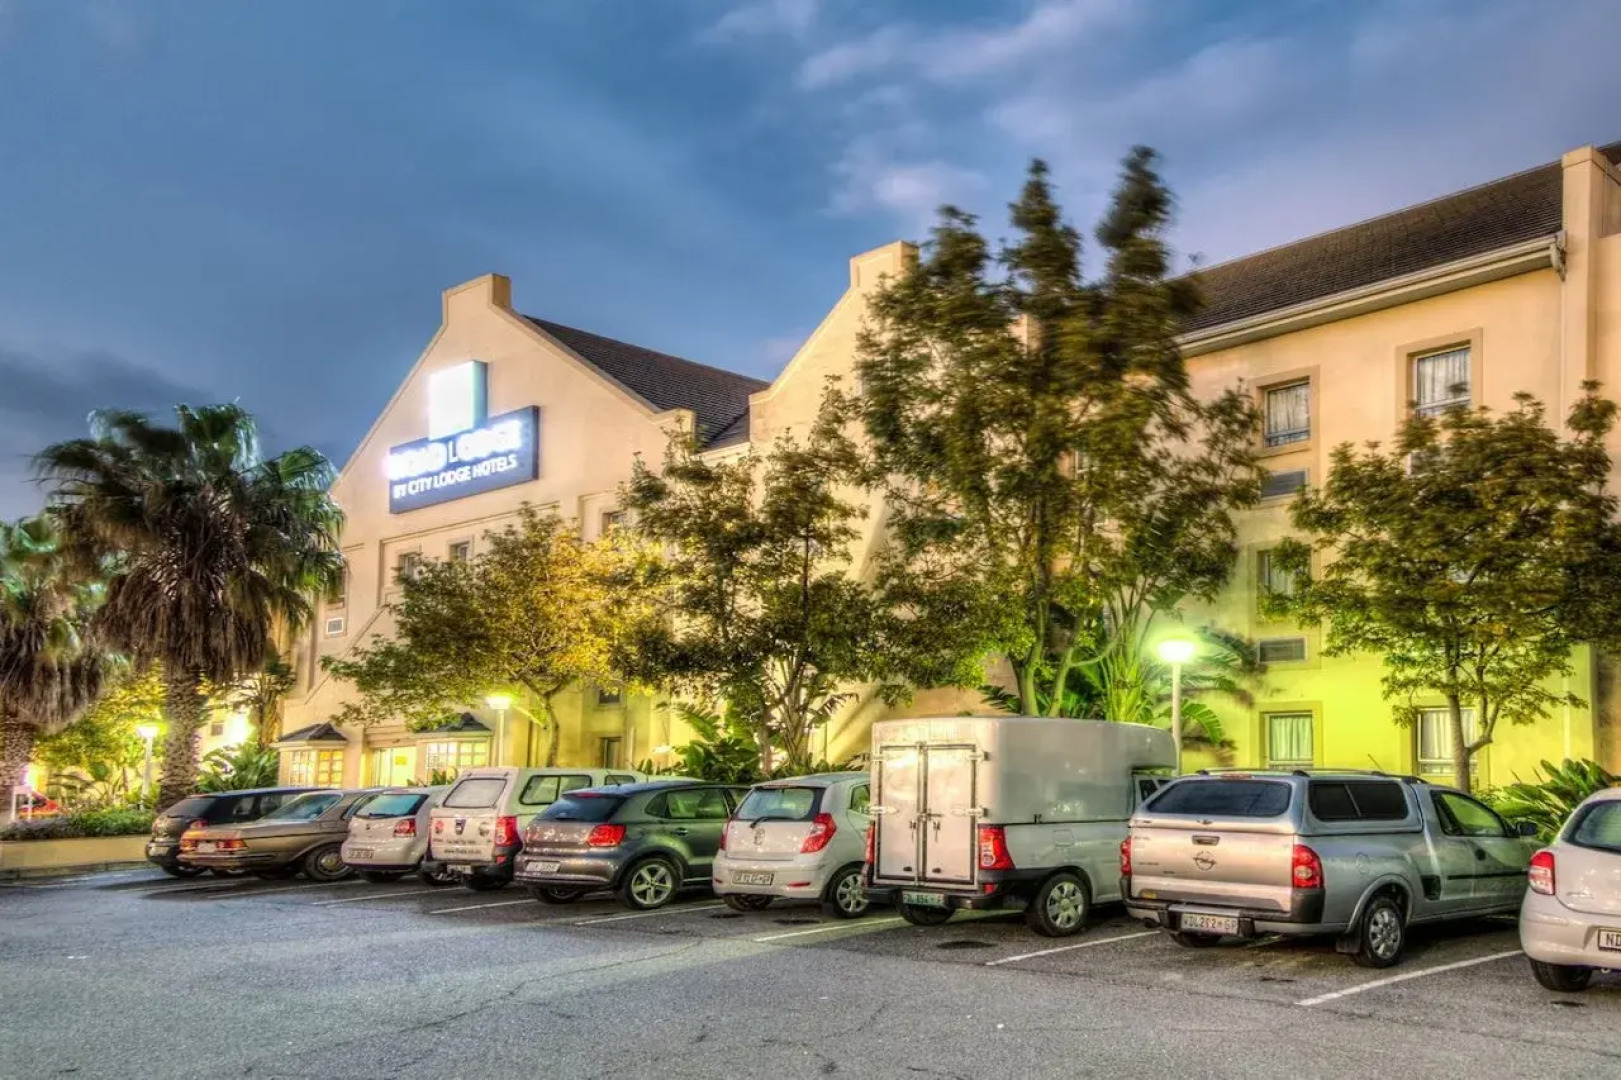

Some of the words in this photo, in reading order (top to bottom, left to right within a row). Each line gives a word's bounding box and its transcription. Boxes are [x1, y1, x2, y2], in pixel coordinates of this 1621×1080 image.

[393, 484, 407, 499] BY
[408, 477, 433, 495] CITY
[433, 465, 472, 487] LODGE
[472, 454, 518, 478] HOTELS
